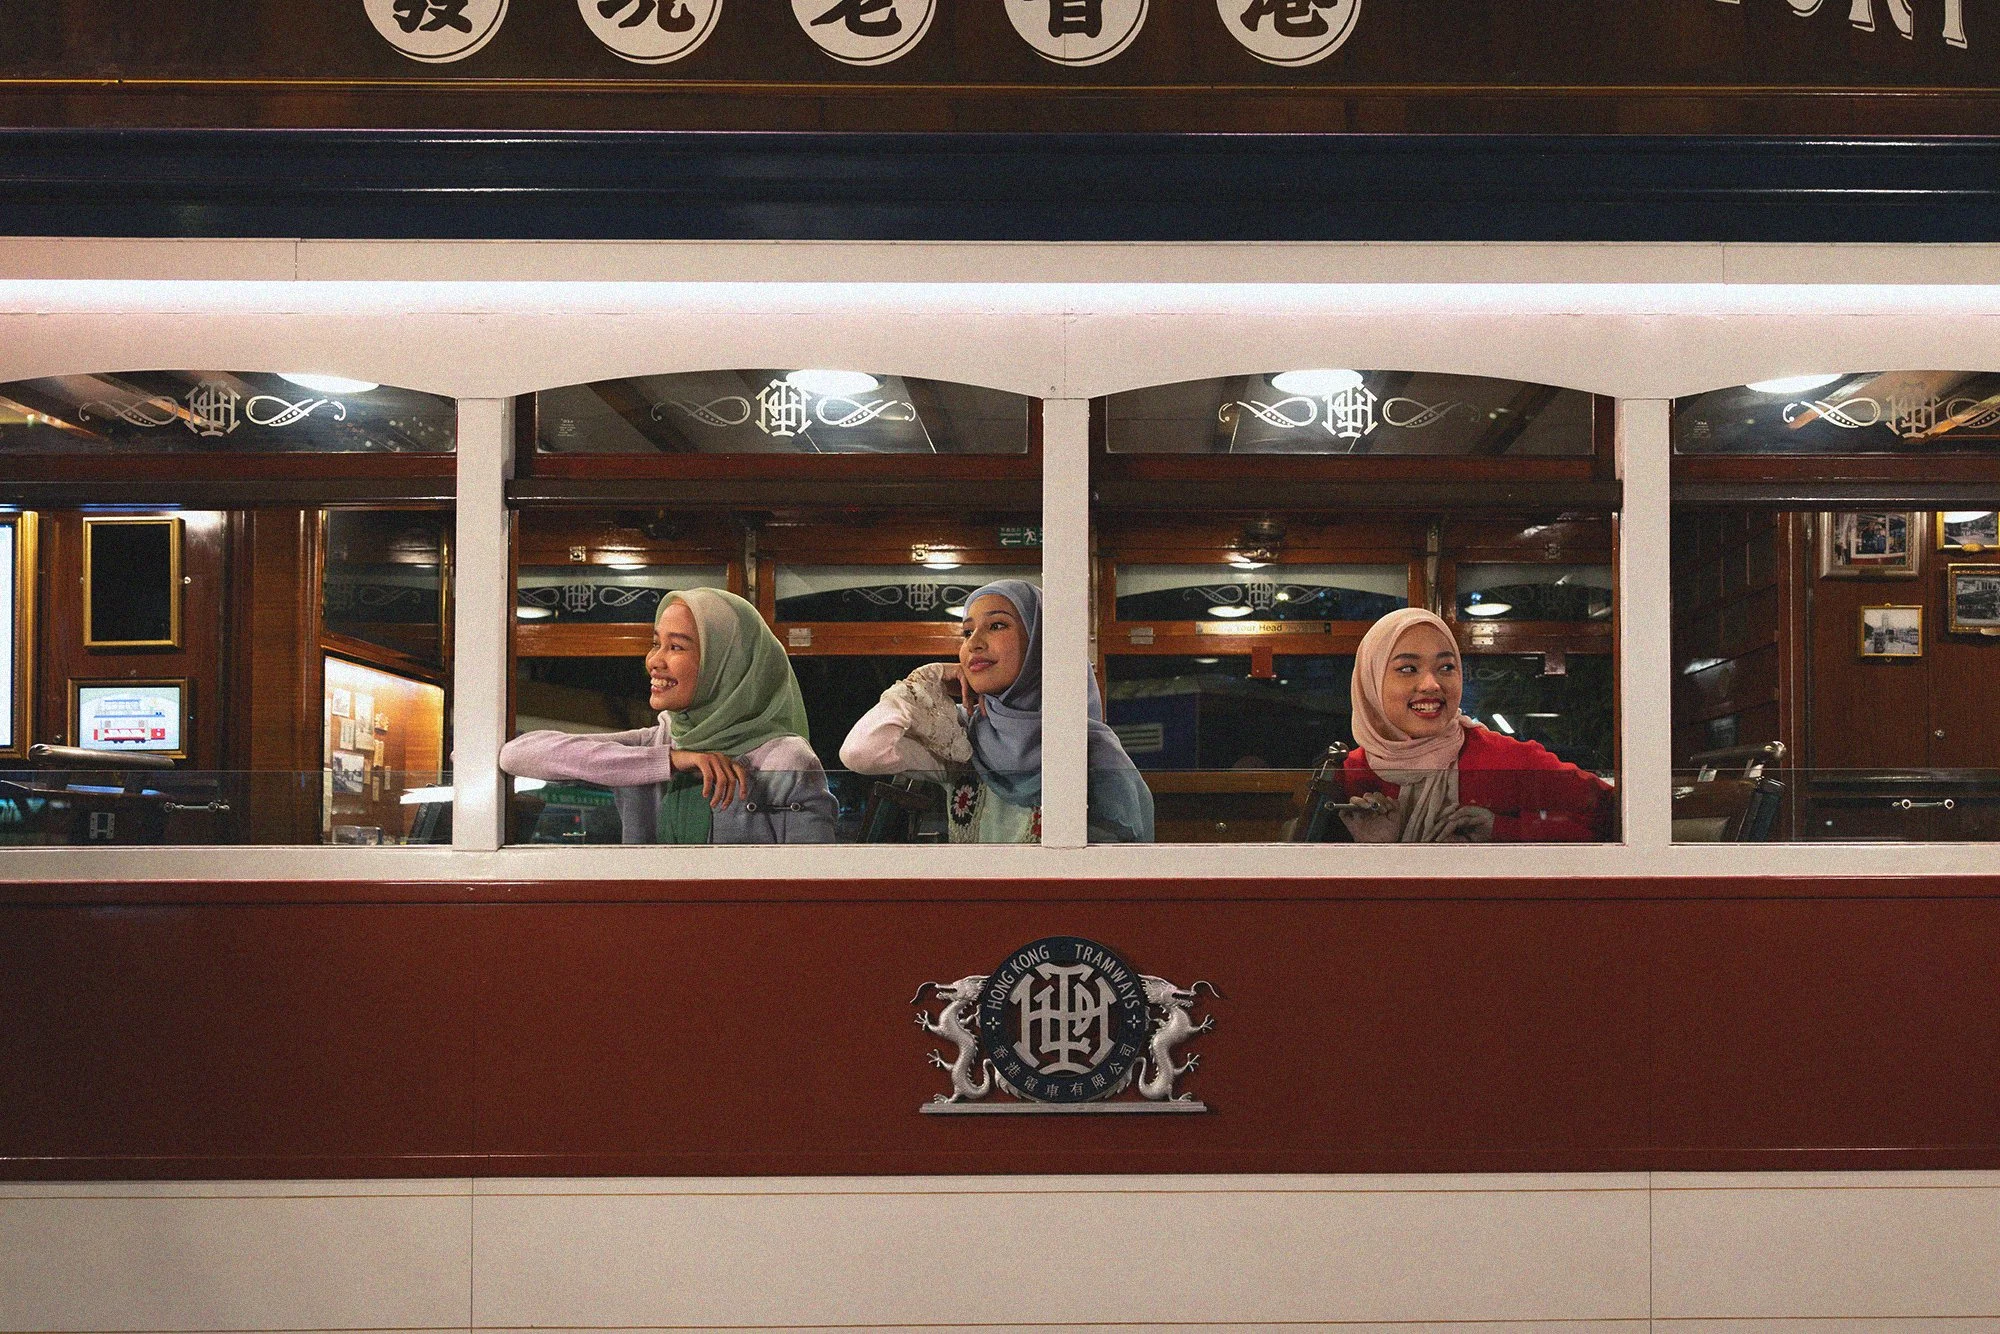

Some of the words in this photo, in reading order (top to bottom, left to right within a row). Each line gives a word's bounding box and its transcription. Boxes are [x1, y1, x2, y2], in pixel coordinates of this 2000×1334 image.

[1259, 624, 1283, 632] Head
[986, 969, 1016, 1011] HONG
[1010, 944, 1050, 974] KONG
[1074, 943, 1140, 1010] TRAMWAYS
